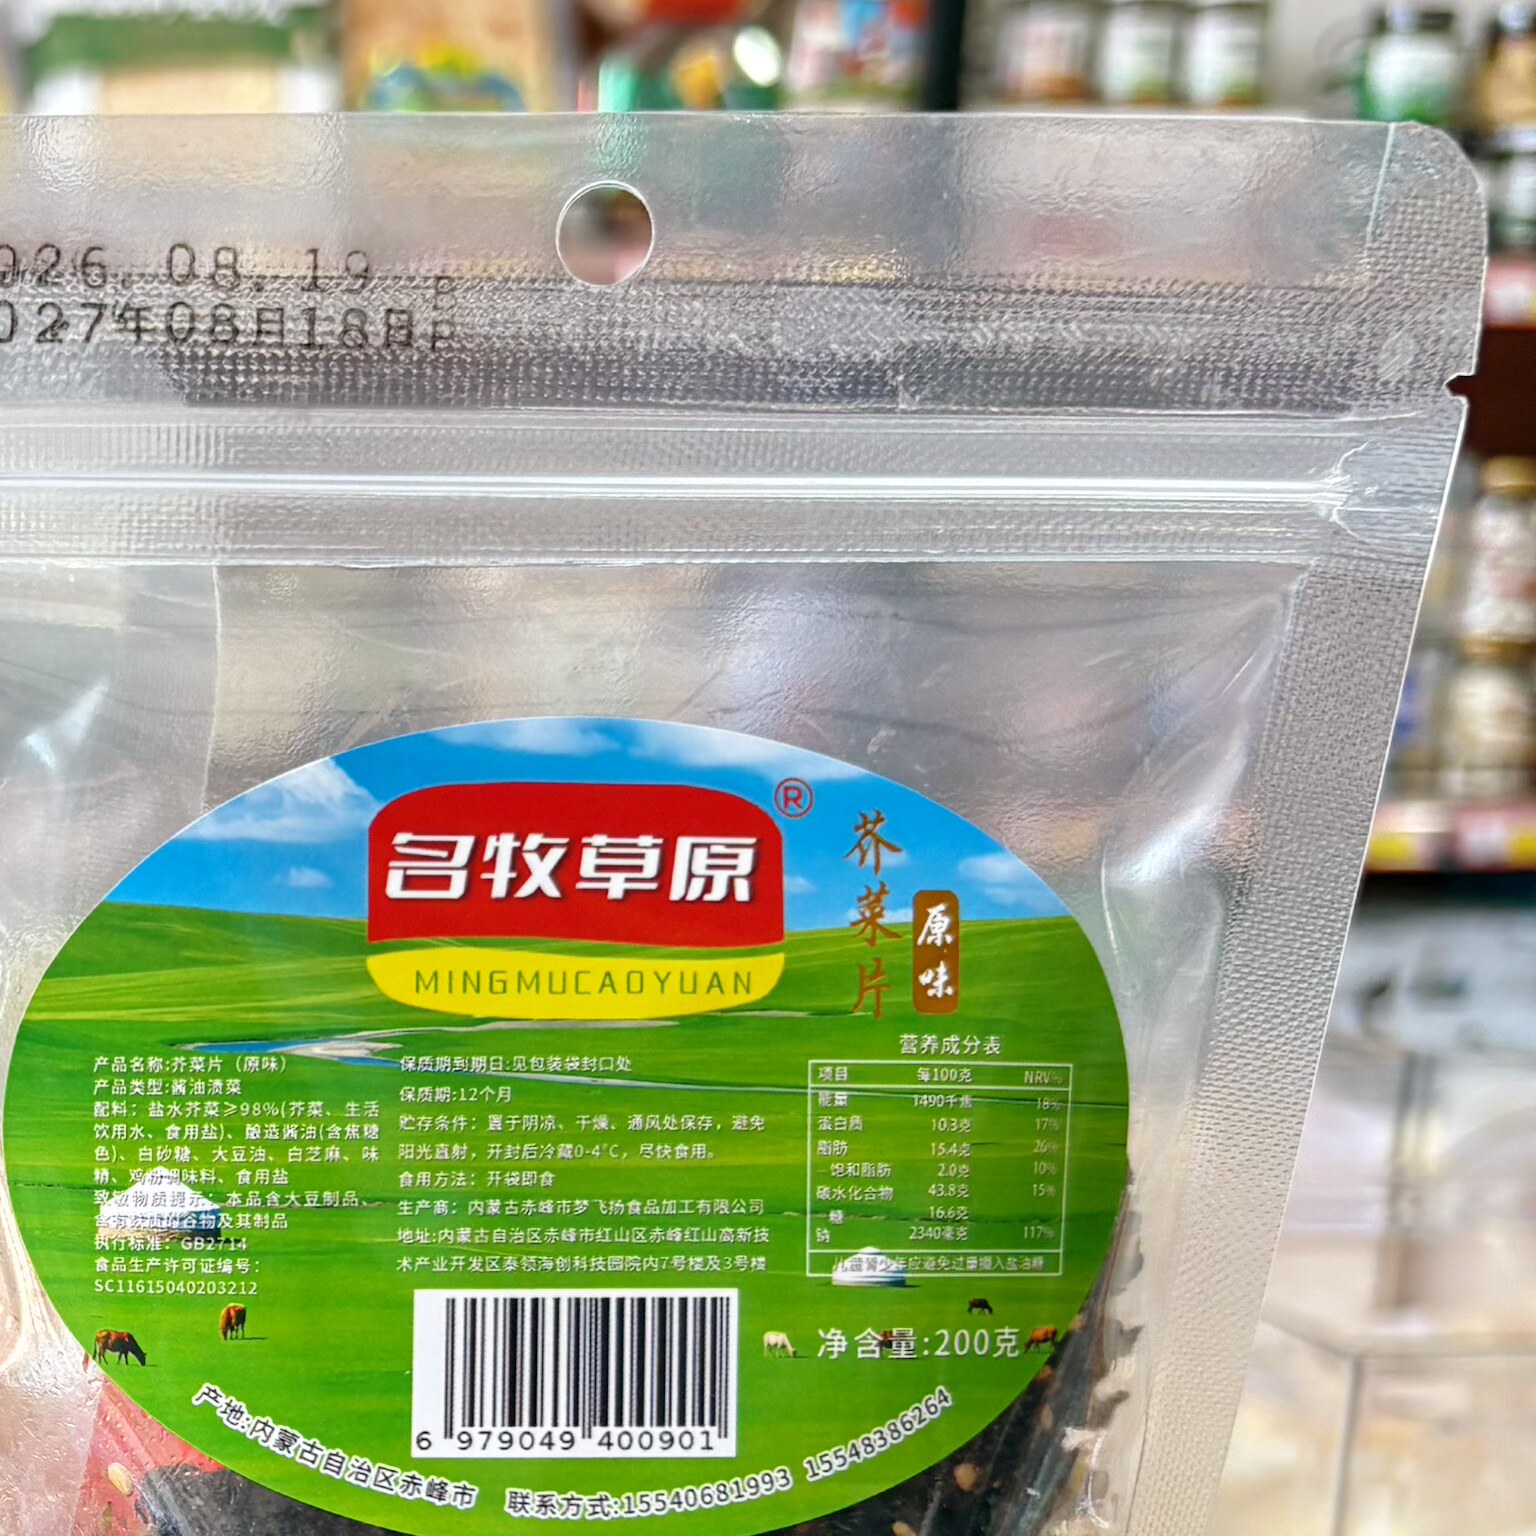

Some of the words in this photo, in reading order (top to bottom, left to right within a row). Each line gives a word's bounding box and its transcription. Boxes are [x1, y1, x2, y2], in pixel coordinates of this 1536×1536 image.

[385, 832, 758, 903] 名牧草原
[842, 808, 904, 1020] 芥菜片
[917, 903, 954, 998] 原味
[414, 969, 752, 997] MINGMUCAOYUAN
[899, 1034, 1001, 1055] 营养成分表
[818, 1067, 848, 1082] 项目
[917, 1067, 972, 1083] 每100克
[818, 1116, 863, 1132] 蛋白质
[415, 1433, 433, 1453] 6
[457, 1430, 576, 1452] 979049
[597, 1430, 714, 1452] 400901
[805, 1385, 954, 1482] 15548386264
